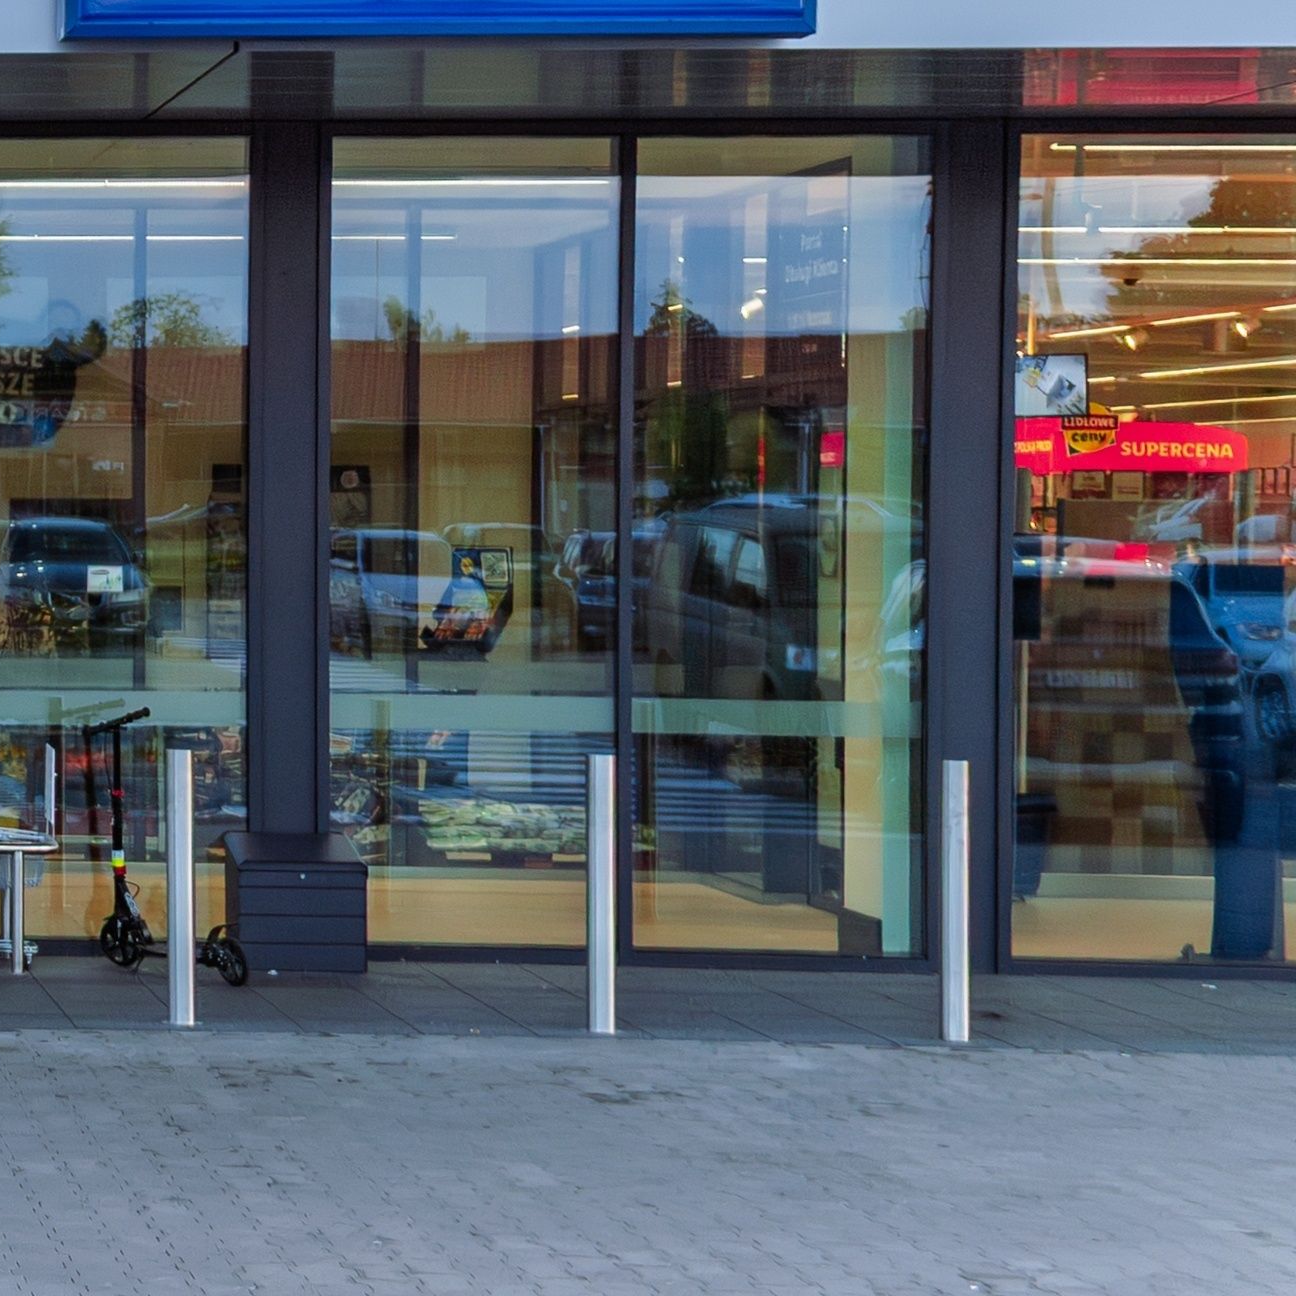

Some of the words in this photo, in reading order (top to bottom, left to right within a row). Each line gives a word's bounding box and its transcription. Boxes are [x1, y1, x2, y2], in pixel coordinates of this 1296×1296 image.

[1063, 416, 1116, 428] LIDLOWE
[1071, 431, 1107, 444] ceny
[1120, 441, 1234, 459] SUPERCENA
